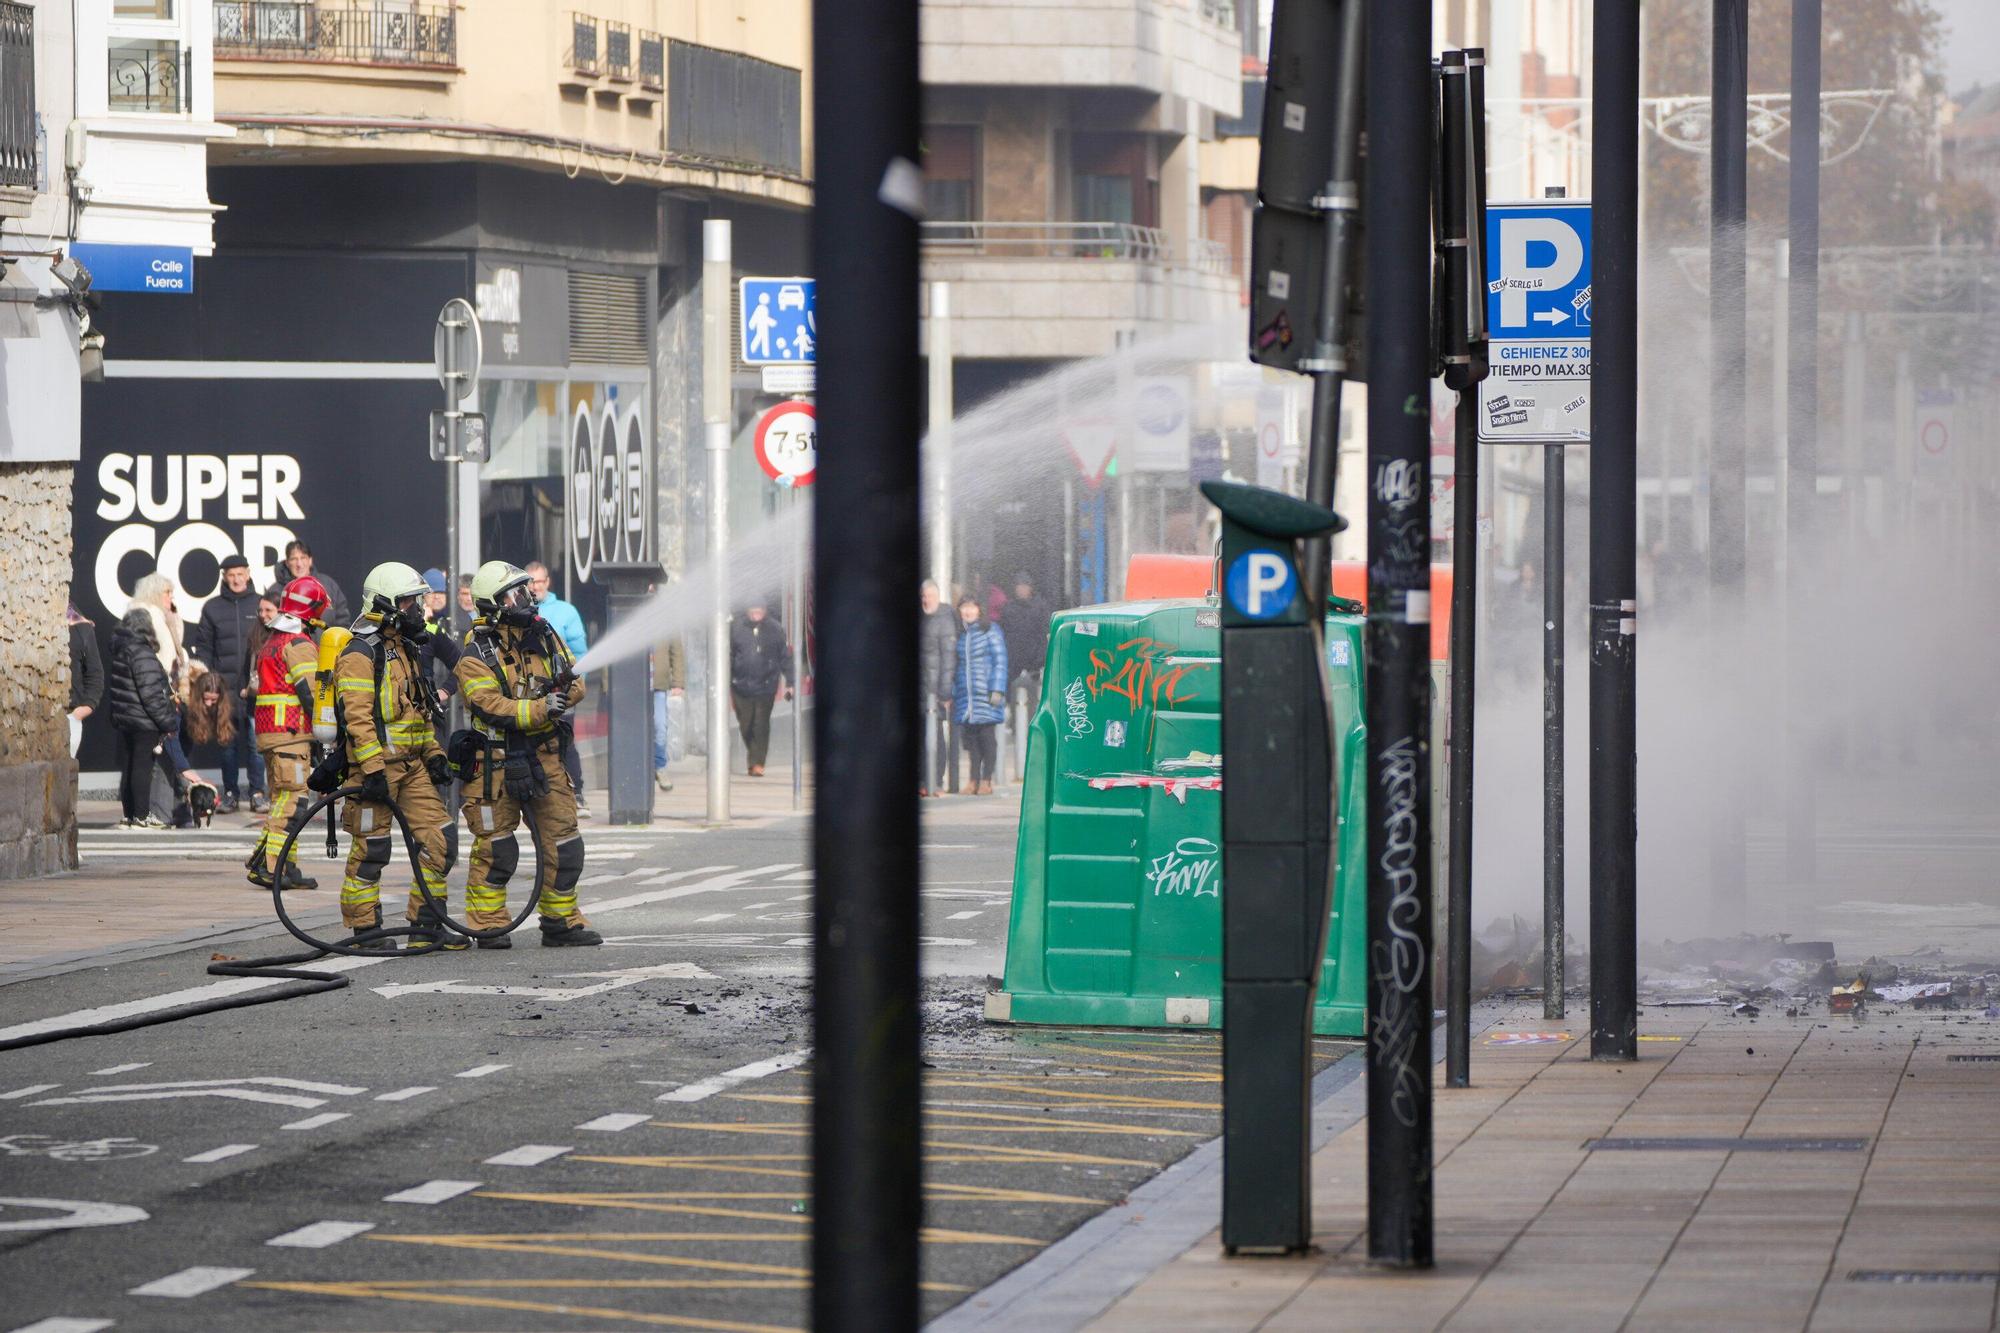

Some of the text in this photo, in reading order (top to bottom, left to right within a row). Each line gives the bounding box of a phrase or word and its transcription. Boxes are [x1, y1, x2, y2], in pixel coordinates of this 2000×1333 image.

[151, 259, 184, 273] Calle
[1500, 217, 1584, 328] P
[145, 275, 184, 289] Fueros
[1500, 346, 1568, 359] GEHIENEZ
[1490, 364, 1542, 377] TIEMPO
[96, 452, 305, 523] SUPER
[1248, 553, 1289, 614] P
